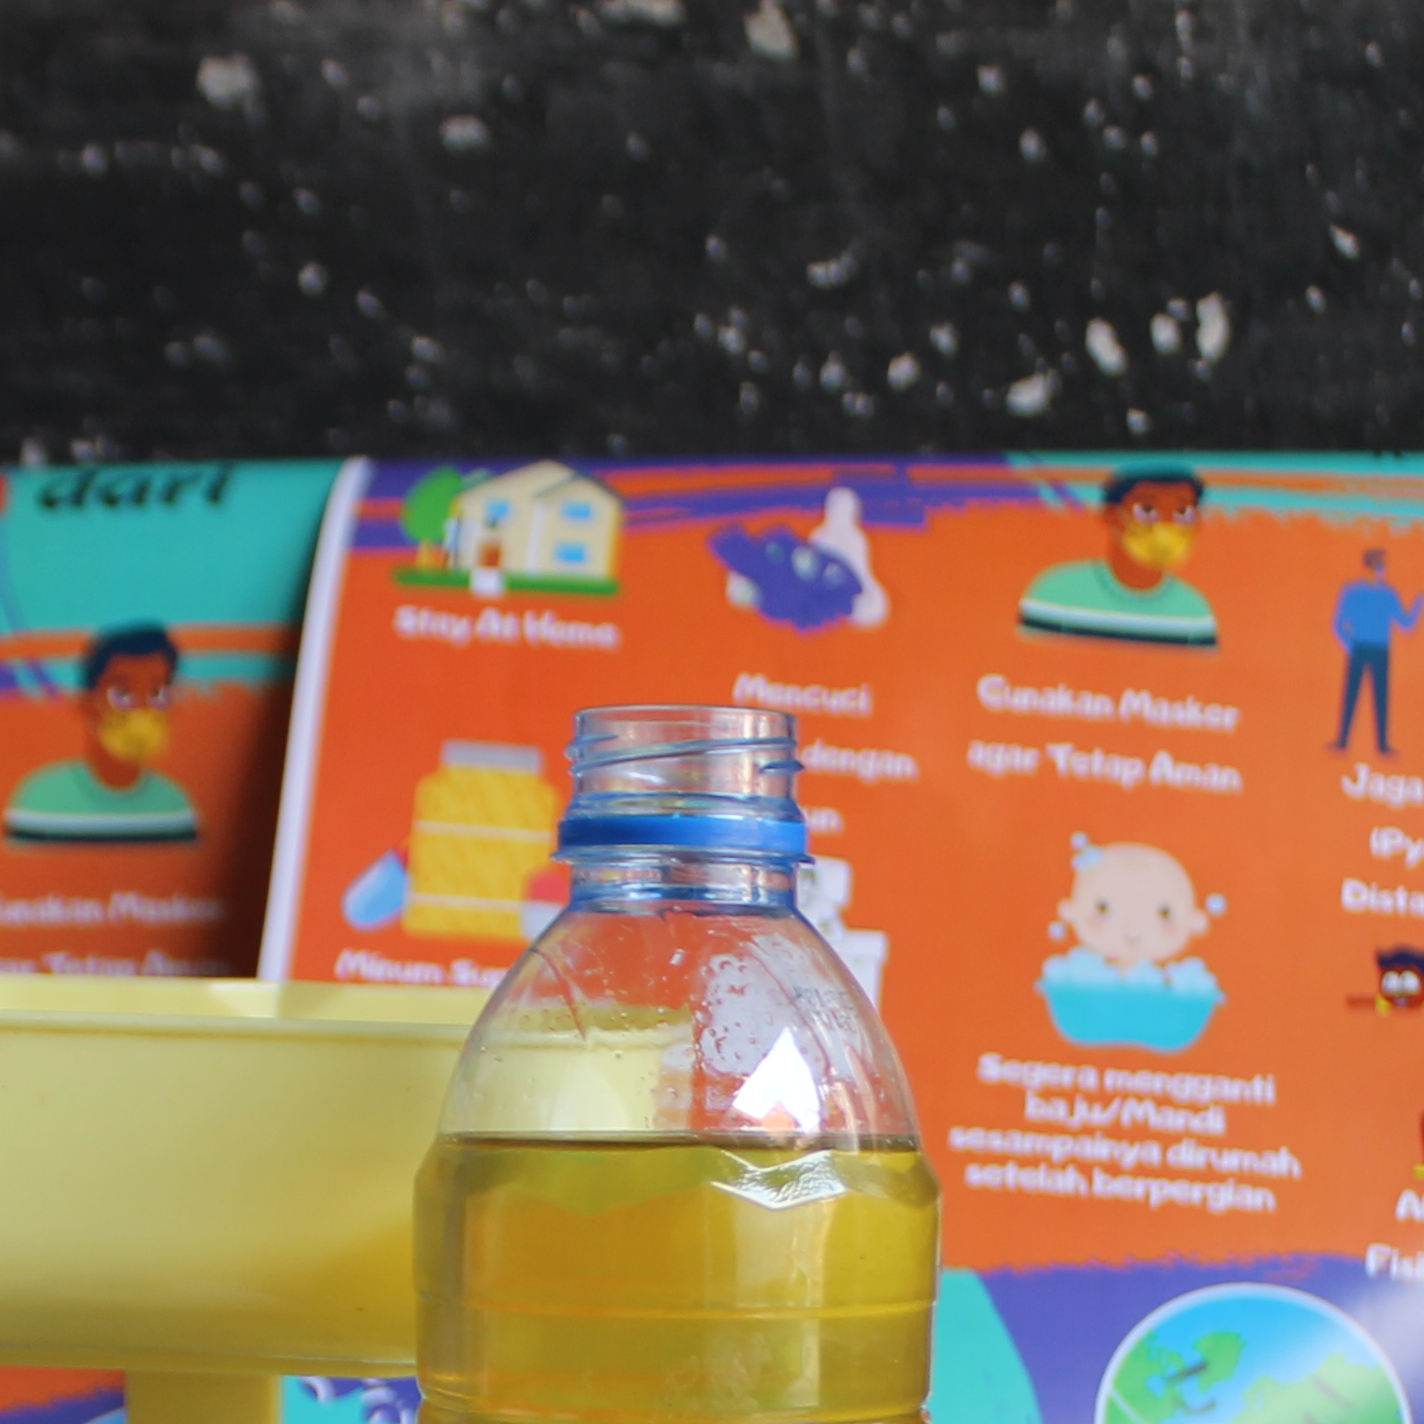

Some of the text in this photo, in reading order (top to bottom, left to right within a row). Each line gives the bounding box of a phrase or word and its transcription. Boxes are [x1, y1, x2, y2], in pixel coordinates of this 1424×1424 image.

[38, 463, 237, 512] dari
[393, 605, 623, 651] Stay At Home
[733, 672, 873, 717] Mencuci
[977, 674, 1241, 734] Gunakan Masker
[967, 739, 1243, 795] agar Tetap Aman
[977, 1051, 1276, 1107] Segera mengganti
[1024, 1090, 1228, 1139] baju/Mandi
[948, 1126, 1303, 1181] sesampainya dirumah
[964, 1161, 1277, 1215] setelah berpergian
